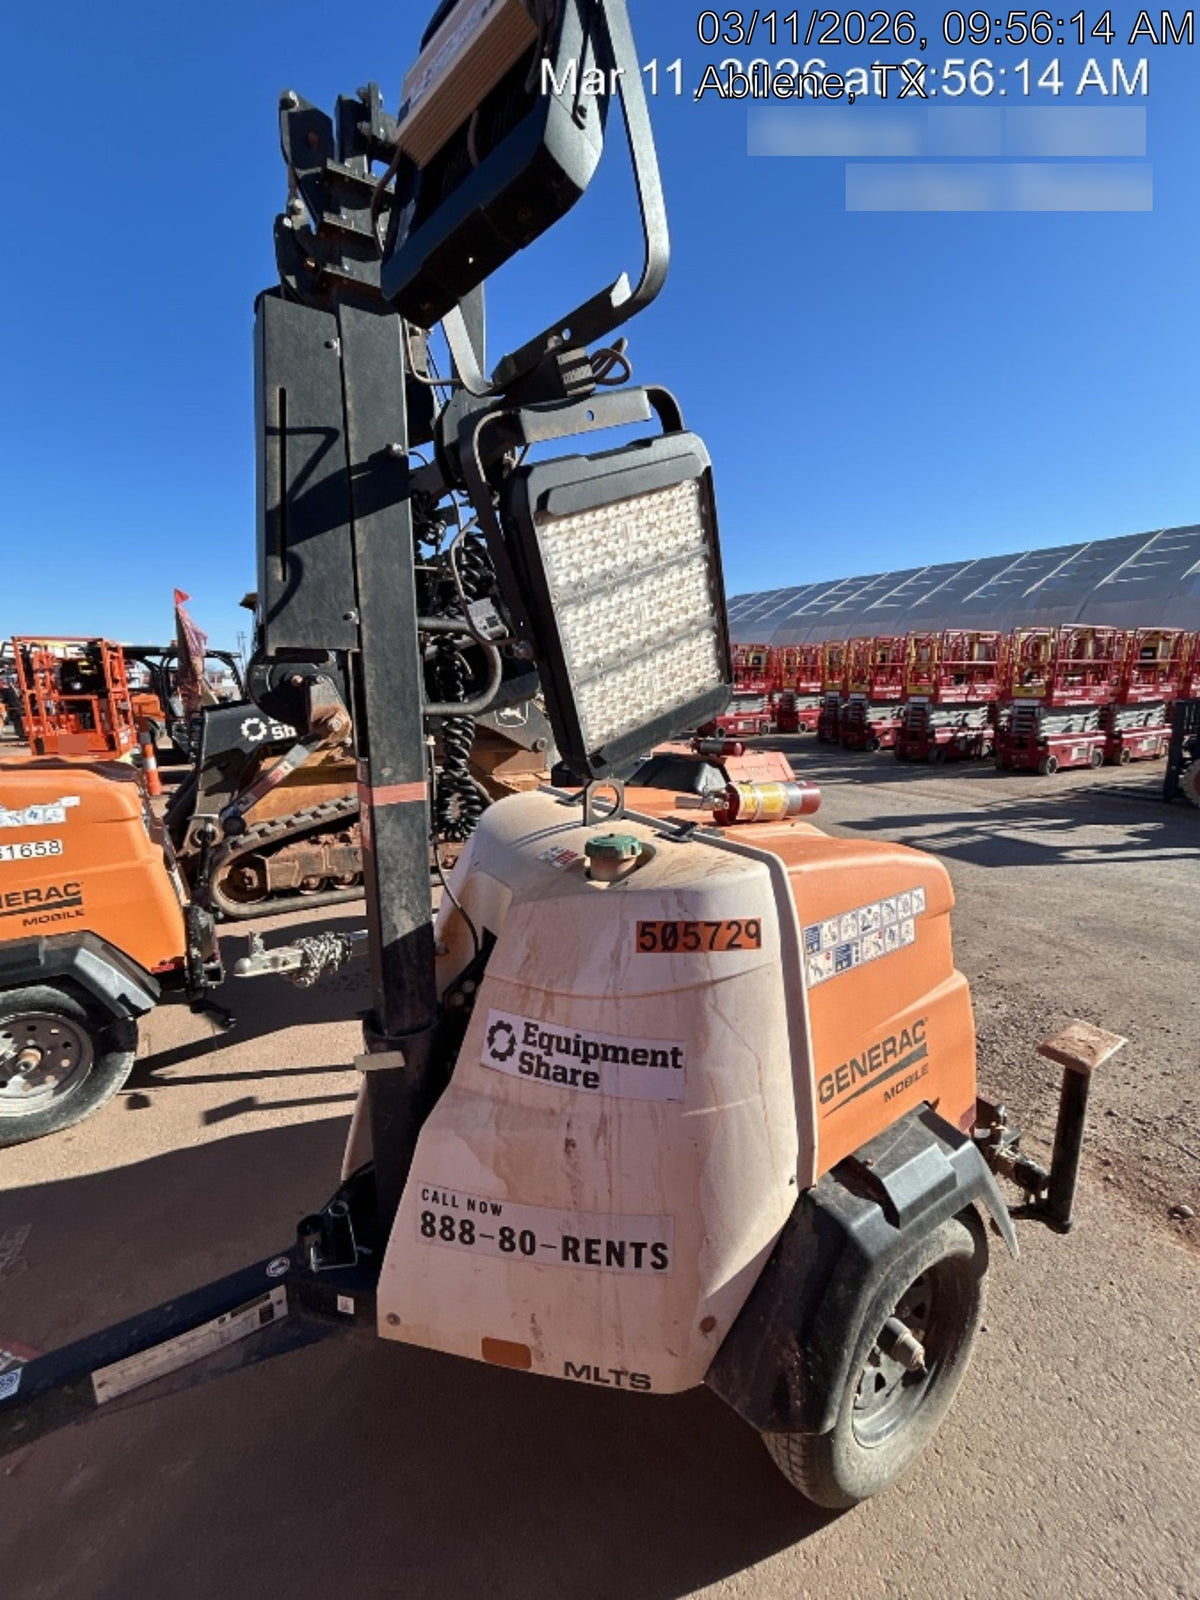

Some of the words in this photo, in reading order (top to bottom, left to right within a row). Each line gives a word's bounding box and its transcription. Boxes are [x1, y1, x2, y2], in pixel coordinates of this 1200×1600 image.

[22, 908, 85, 927] MOBILE
[639, 919, 761, 951] 505729
[522, 1021, 684, 1070] Equipment
[818, 1018, 926, 1105] GENERAC
[518, 1050, 600, 1090] Share
[883, 1063, 929, 1102] MOBILE
[421, 1187, 460, 1209] CALL
[466, 1197, 503, 1217] NOW
[563, 1361, 652, 1391] MLTS
